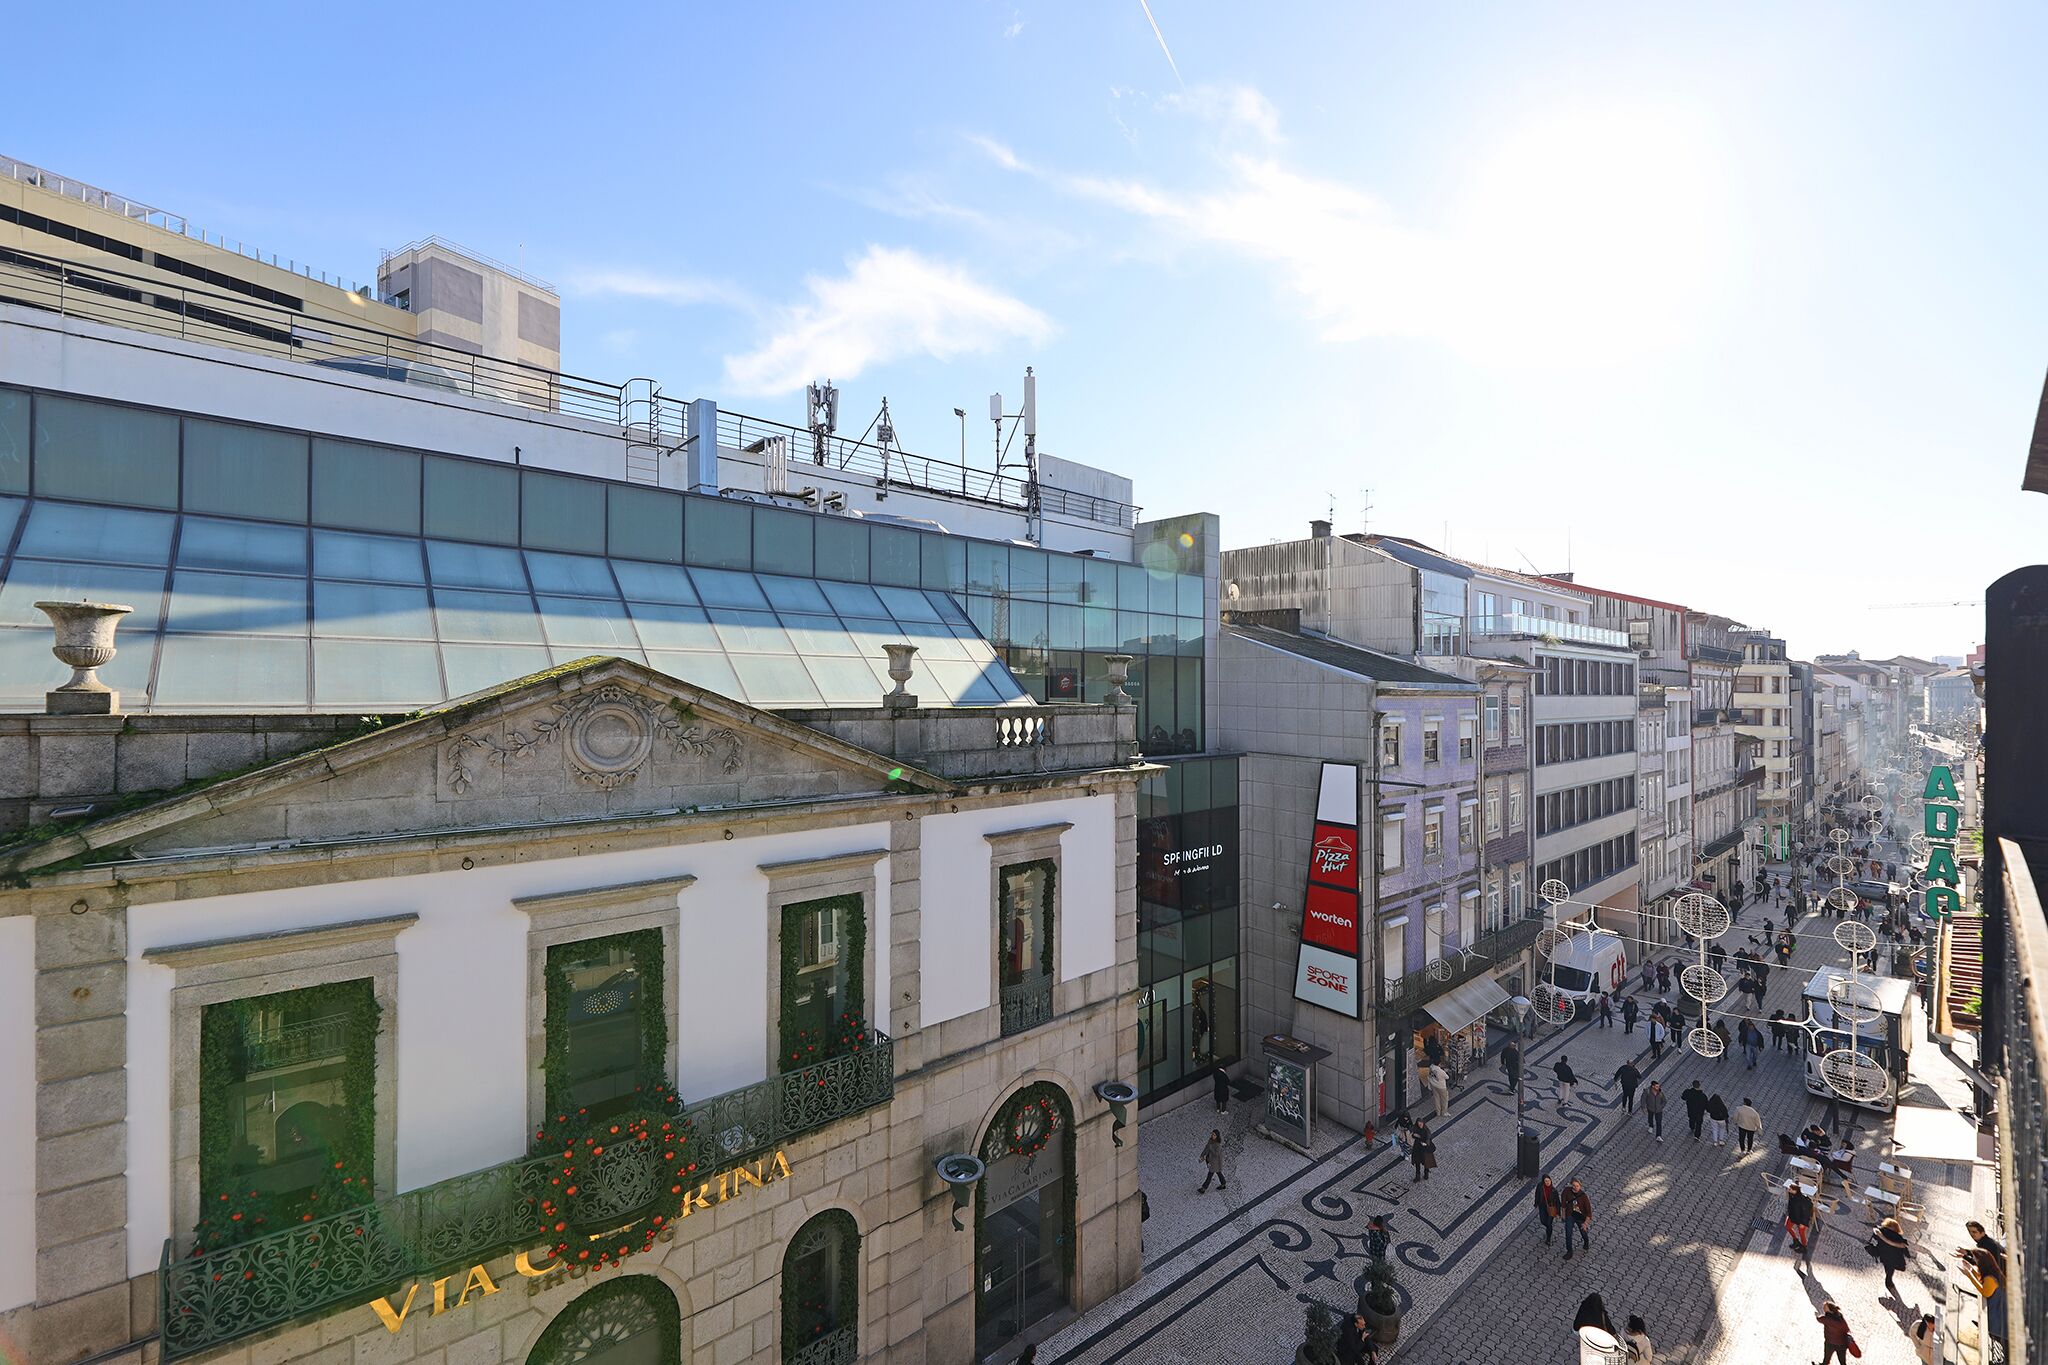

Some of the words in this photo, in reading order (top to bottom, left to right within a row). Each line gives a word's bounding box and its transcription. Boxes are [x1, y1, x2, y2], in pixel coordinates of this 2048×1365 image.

[1315, 848, 1350, 863] Pizza
[1321, 862, 1348, 873] Hut
[1310, 910, 1352, 928] worten
[1307, 965, 1348, 984] SPORT
[1611, 952, 1626, 989] ctt
[1307, 973, 1348, 994] ZONE
[369, 1264, 500, 1334] VIA
[515, 1151, 794, 1277] CRINA
